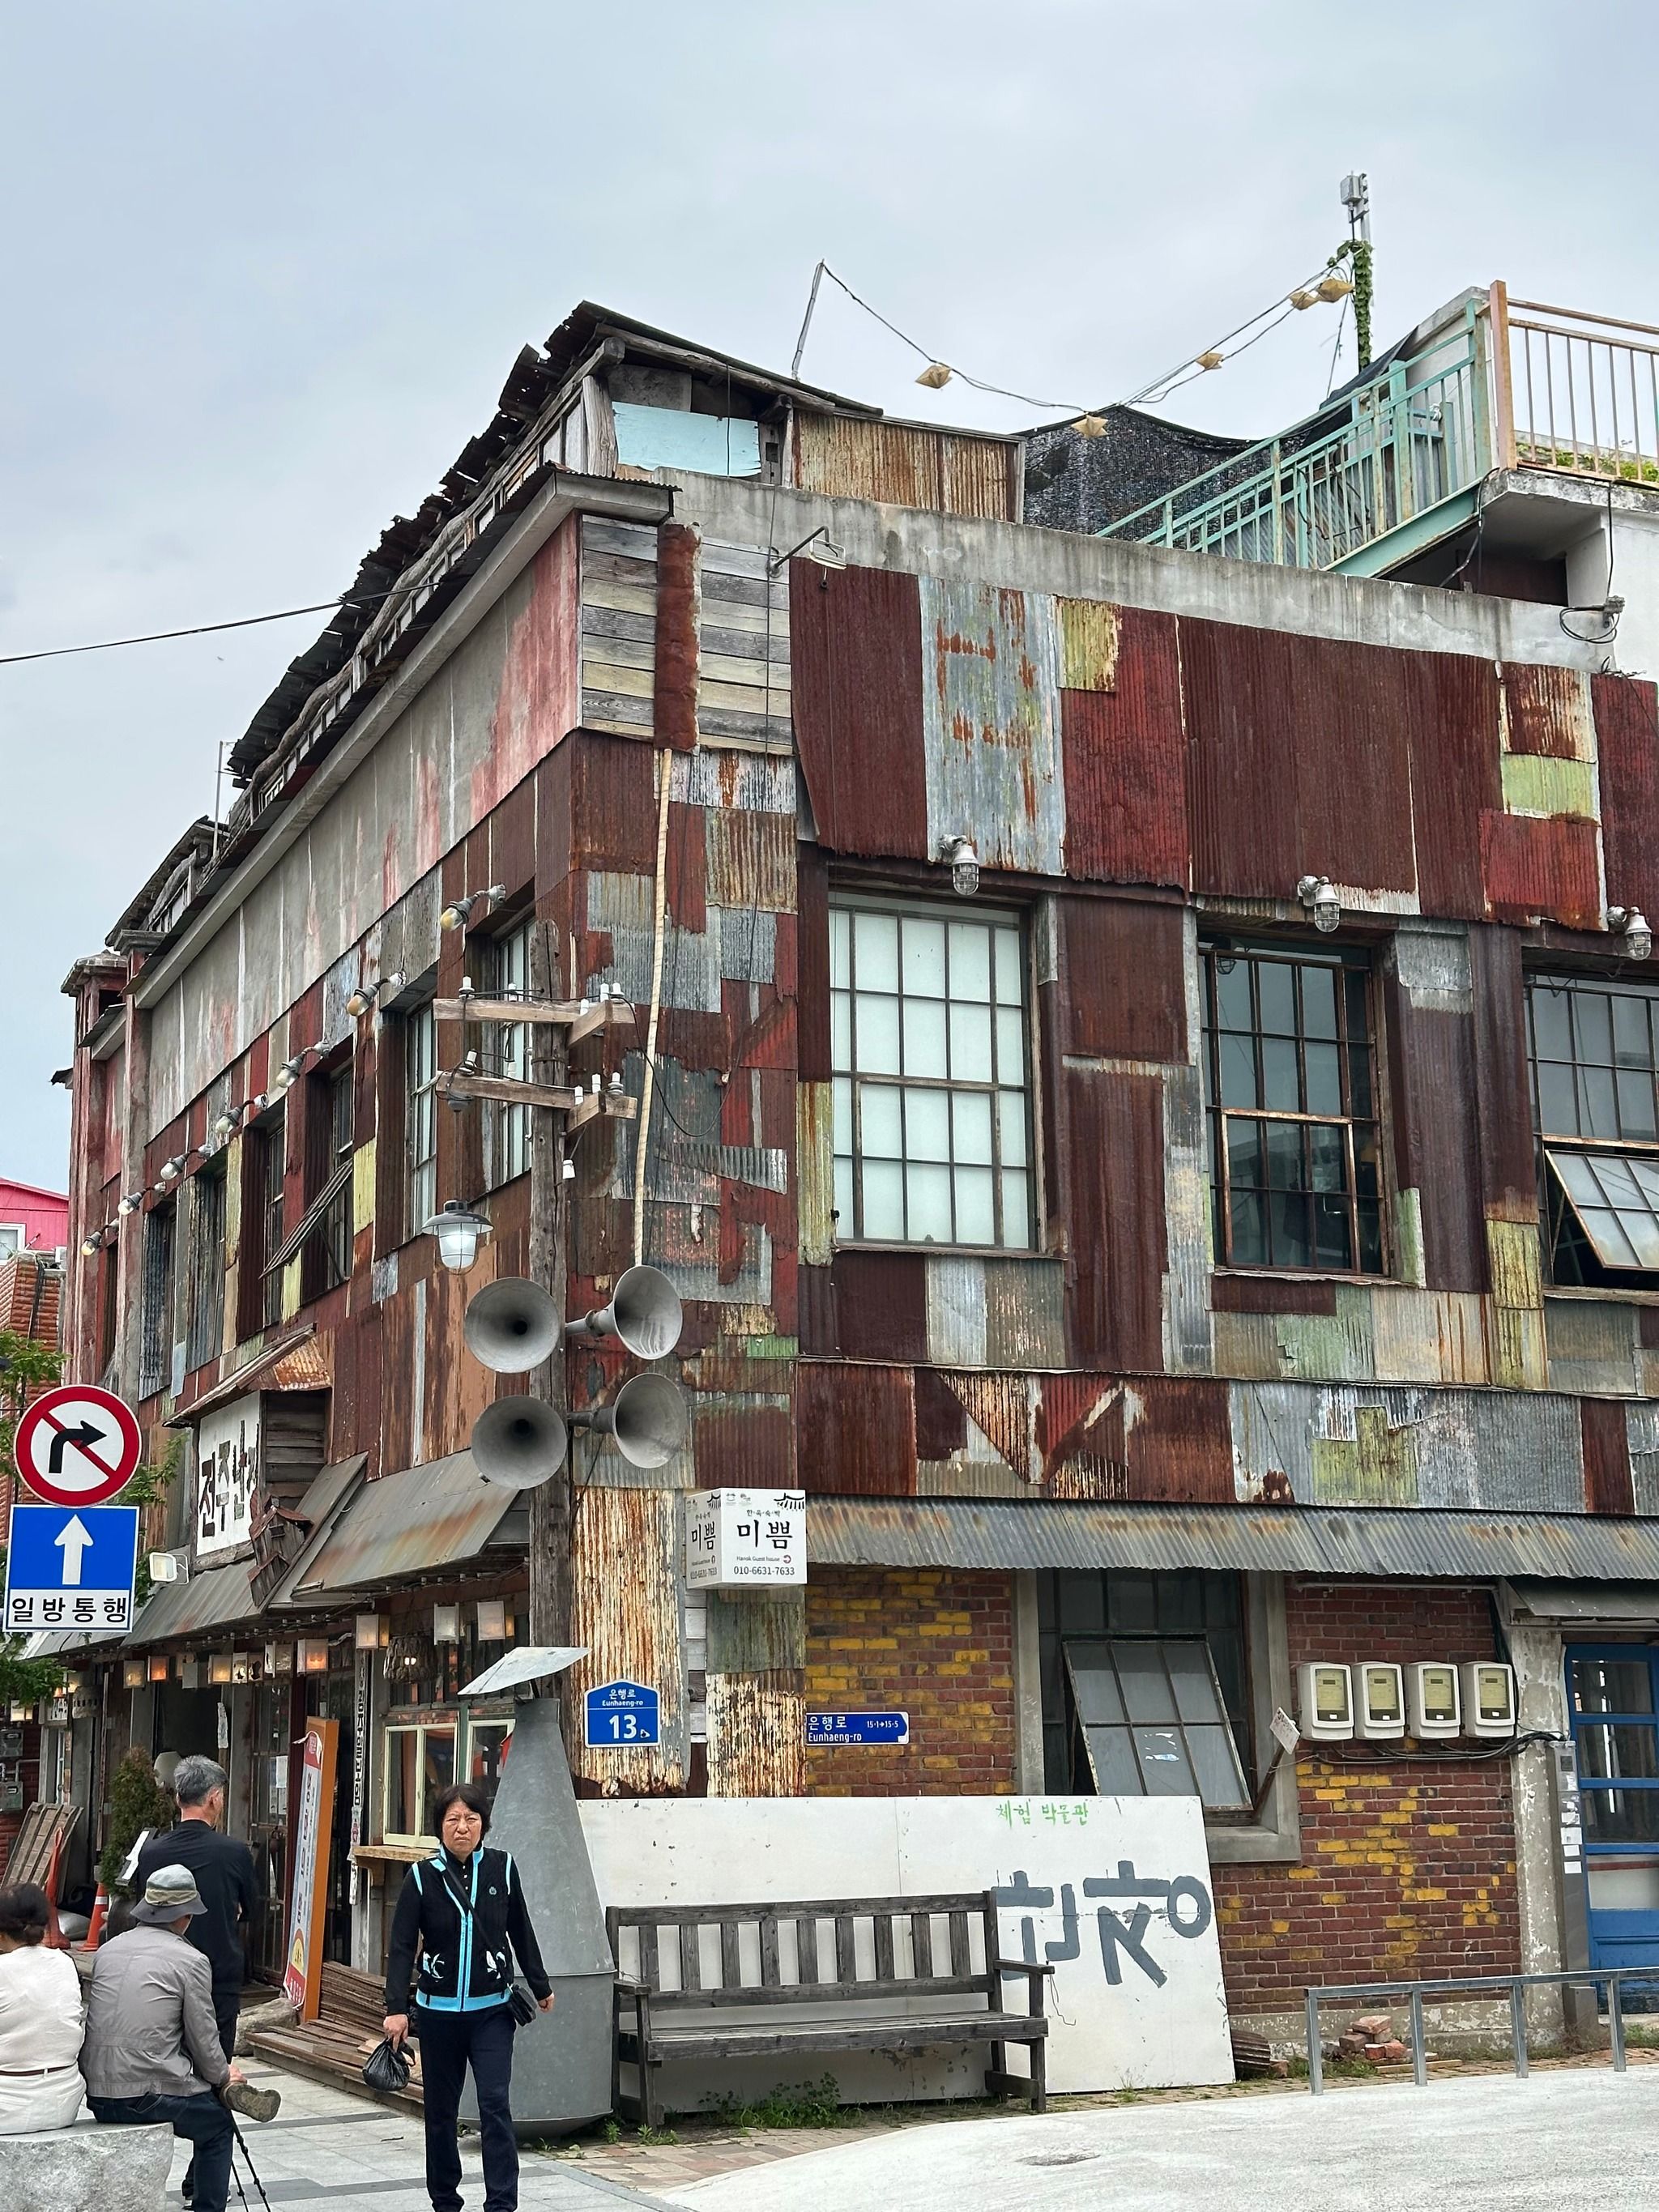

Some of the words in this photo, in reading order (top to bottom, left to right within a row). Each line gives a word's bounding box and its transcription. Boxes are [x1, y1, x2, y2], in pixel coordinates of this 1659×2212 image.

[691, 1521, 716, 1552] 미쁨
[736, 1519, 794, 1550] 미쁨
[733, 1565, 795, 1575] 010-6631-7633
[12, 1596, 126, 1623] 일방통행
[602, 1699, 644, 1707] Eunhaeng-ro
[608, 1714, 638, 1739] 13
[808, 1715, 847, 1731] 은행로
[808, 1732, 862, 1743] Eunhaeng-ro
[996, 1799, 1031, 1828] 체험
[1042, 1801, 1089, 1826] 박물관
